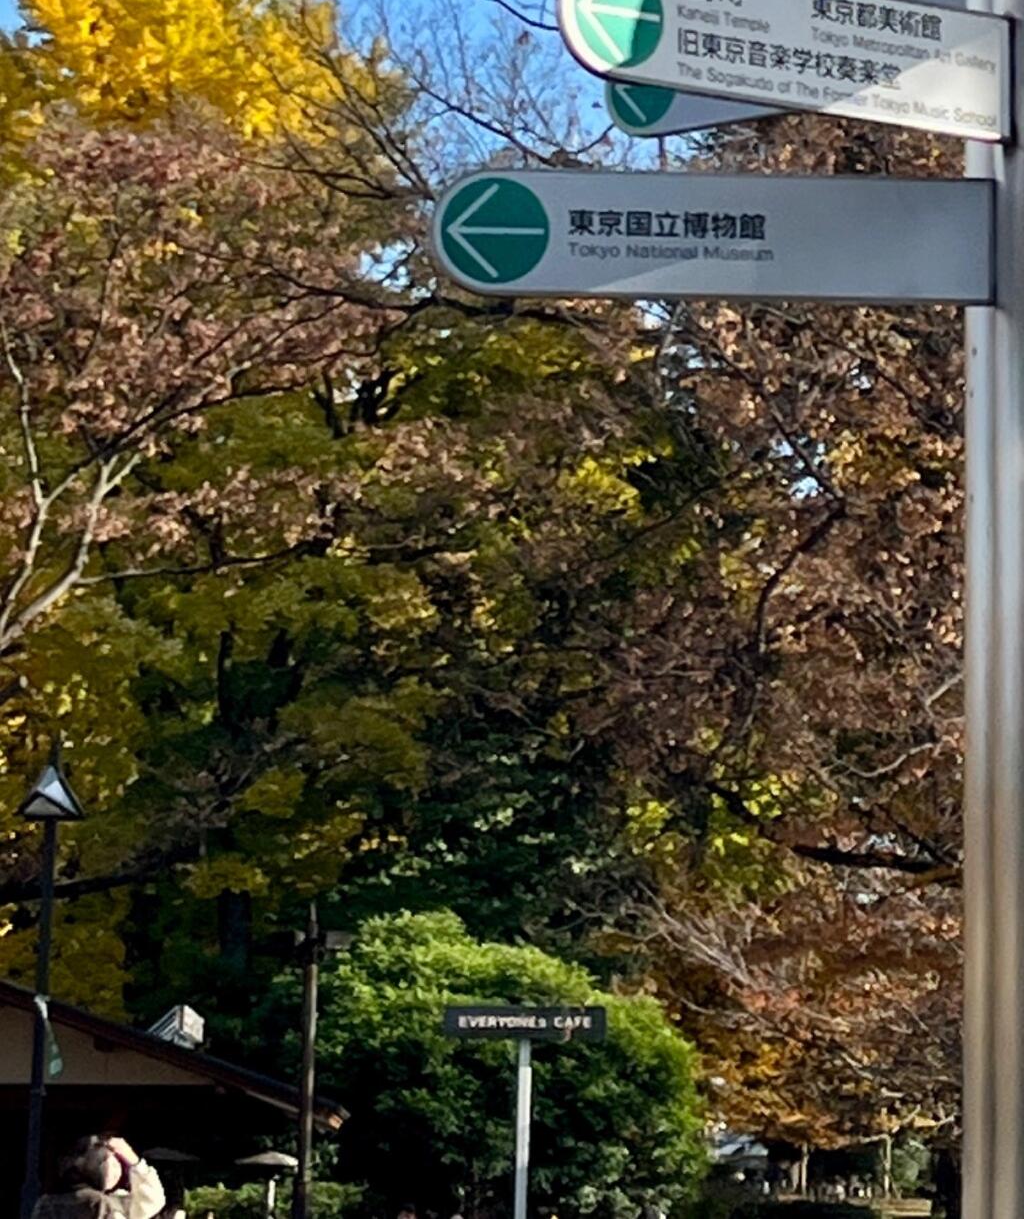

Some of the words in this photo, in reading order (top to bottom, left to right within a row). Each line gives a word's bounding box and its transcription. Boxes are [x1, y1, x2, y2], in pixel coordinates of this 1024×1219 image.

[723, 11, 770, 33] Temple
[677, 27, 902, 91] 旧東京音楽学校奏楽堂
[810, 26, 849, 48] Tokyo
[954, 51, 996, 75] Gallery
[677, 61, 702, 80] The
[777, 80, 792, 93] of
[796, 81, 819, 98] The
[872, 94, 910, 115] Tokyo
[913, 101, 949, 120] Music
[953, 107, 997, 128] School
[568, 209, 766, 240] 東京国立博物館
[568, 241, 621, 260] Tokyo
[626, 244, 698, 259] National
[703, 246, 774, 261] Museum
[553, 1015, 592, 1029] CAFE
